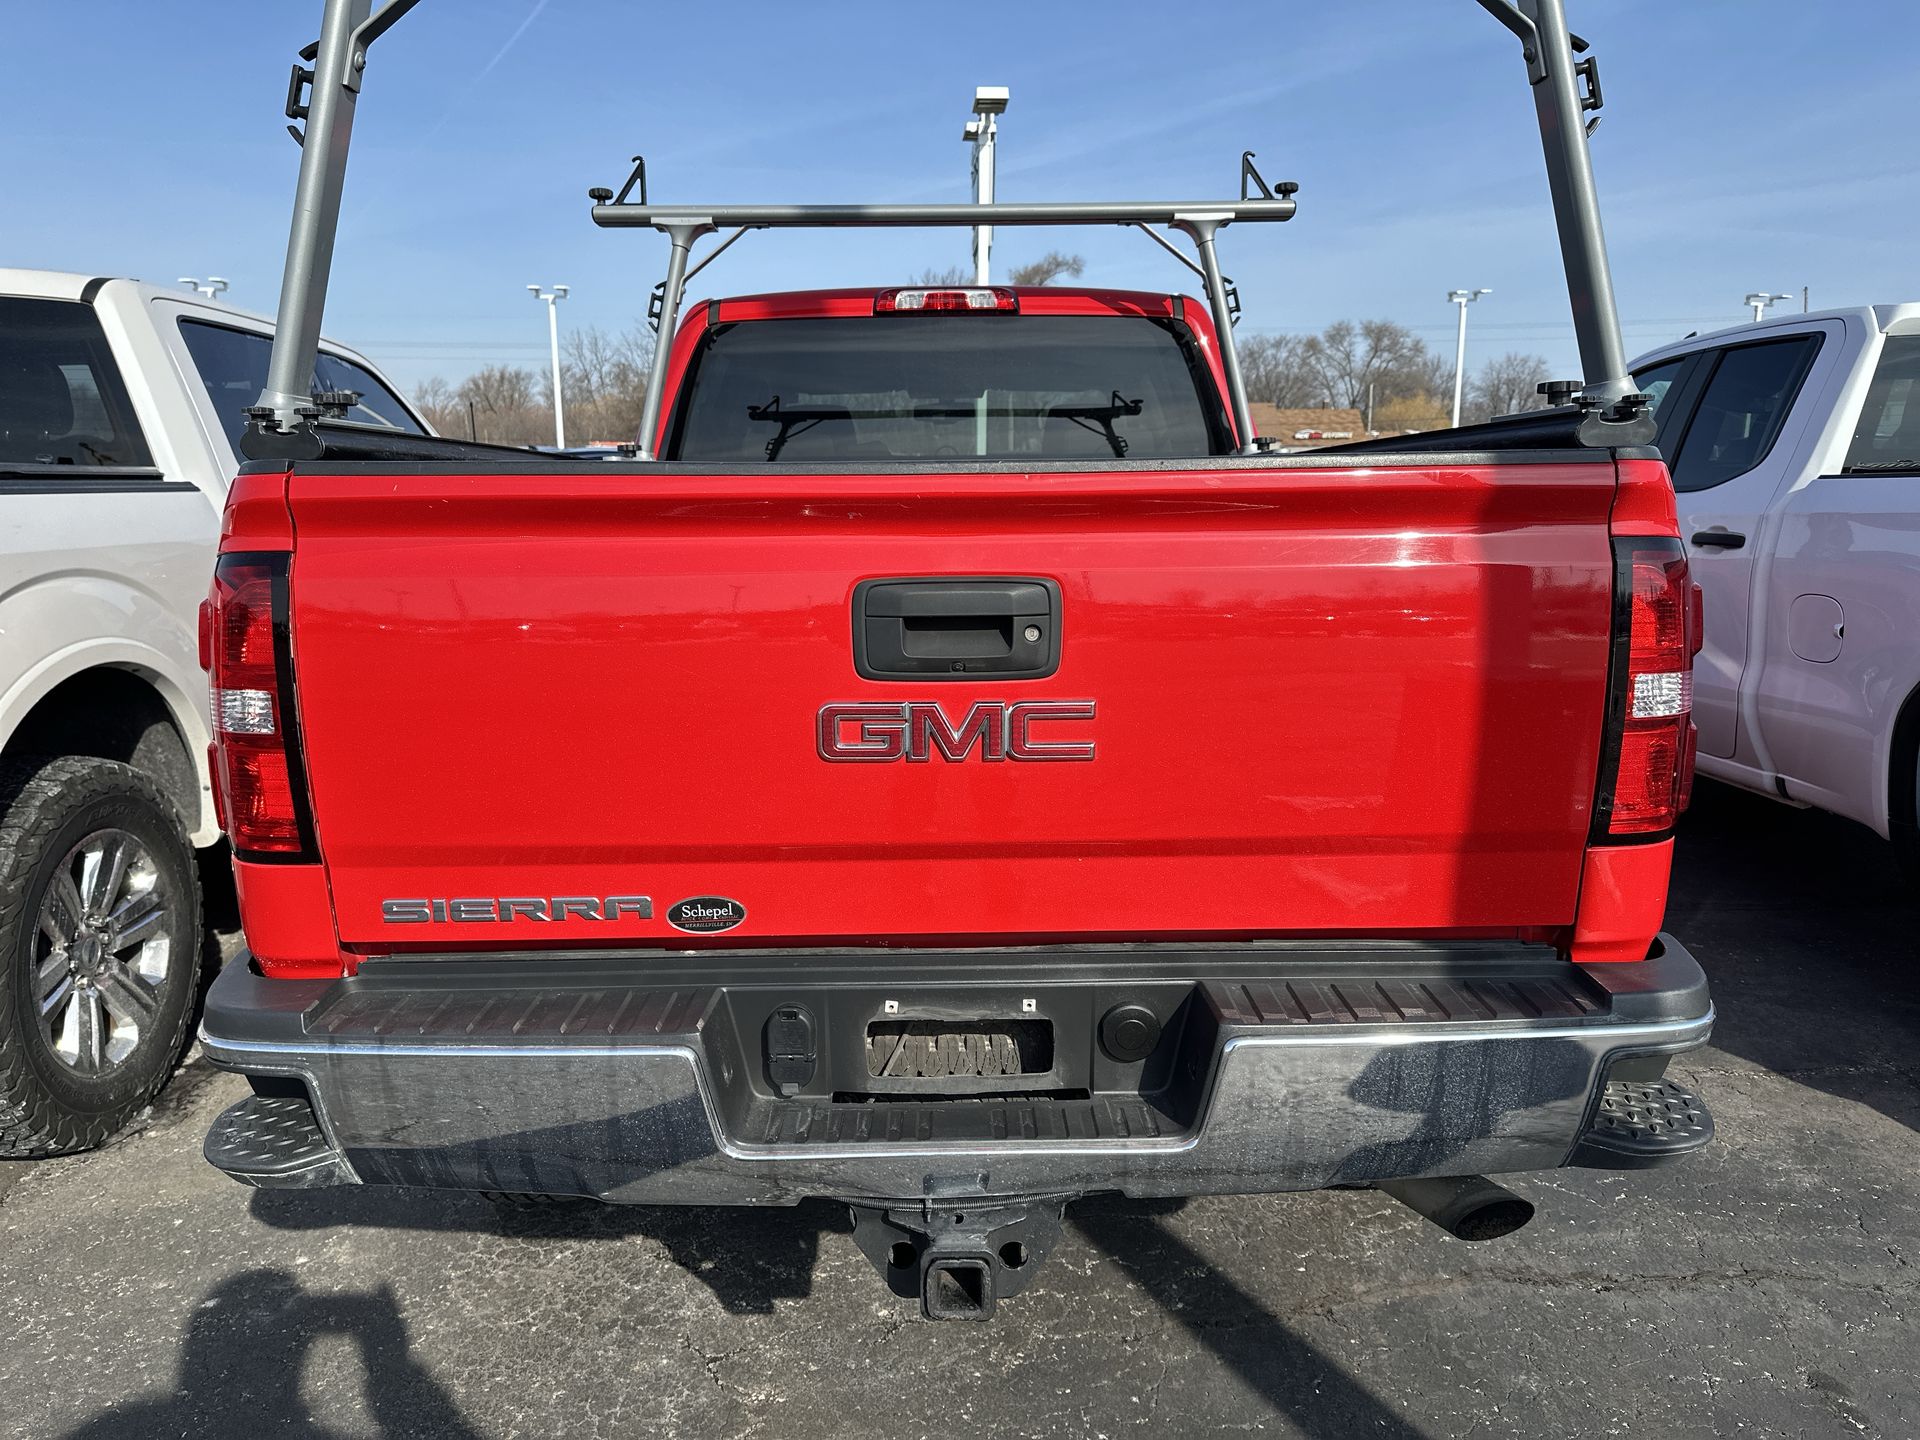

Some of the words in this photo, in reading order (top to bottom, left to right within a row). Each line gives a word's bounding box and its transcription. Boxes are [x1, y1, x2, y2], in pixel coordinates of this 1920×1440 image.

[817, 700, 1097, 762] GMC
[382, 895, 653, 923] SIERRA
[682, 903, 734, 919] Schepel
